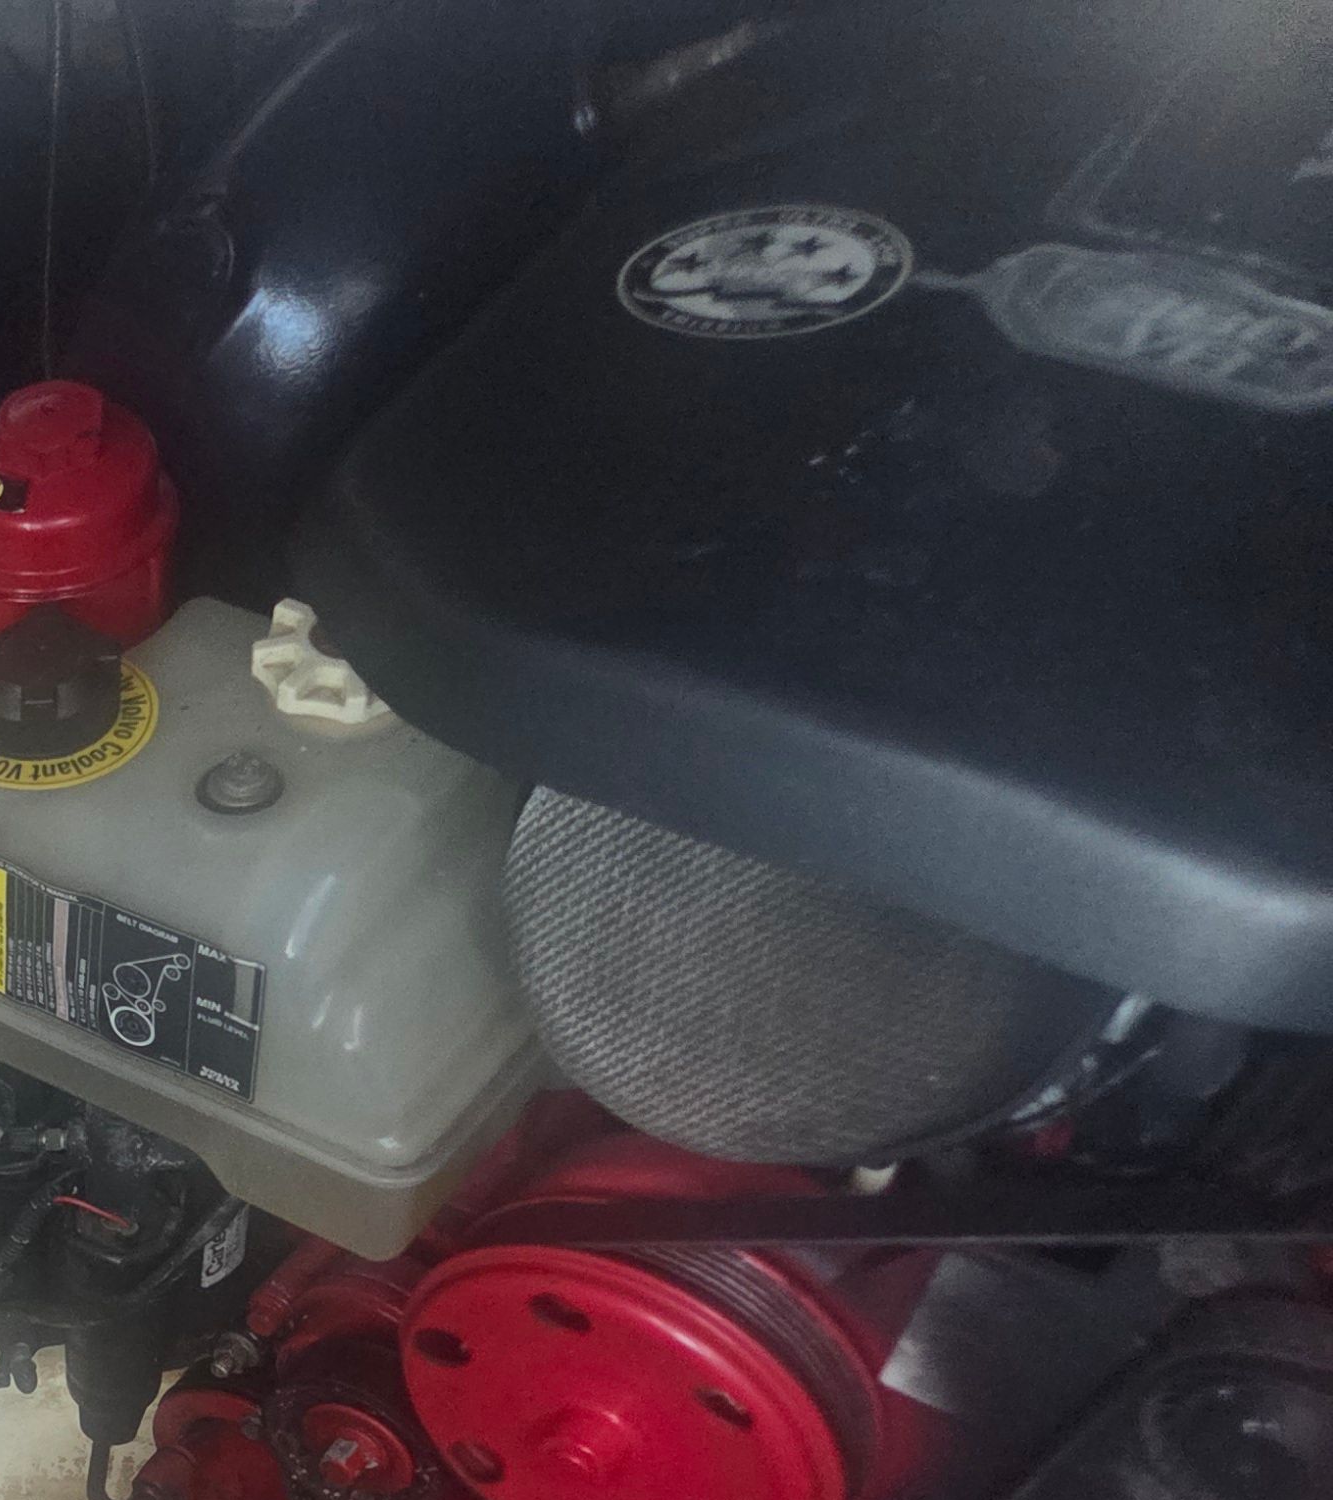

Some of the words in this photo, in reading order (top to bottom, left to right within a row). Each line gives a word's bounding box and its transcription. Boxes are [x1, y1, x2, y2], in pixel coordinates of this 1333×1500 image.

[113, 693, 146, 739] Volvo
[29, 741, 124, 781] Coolant
[197, 943, 228, 963] MAX
[196, 996, 221, 1013] MIN
